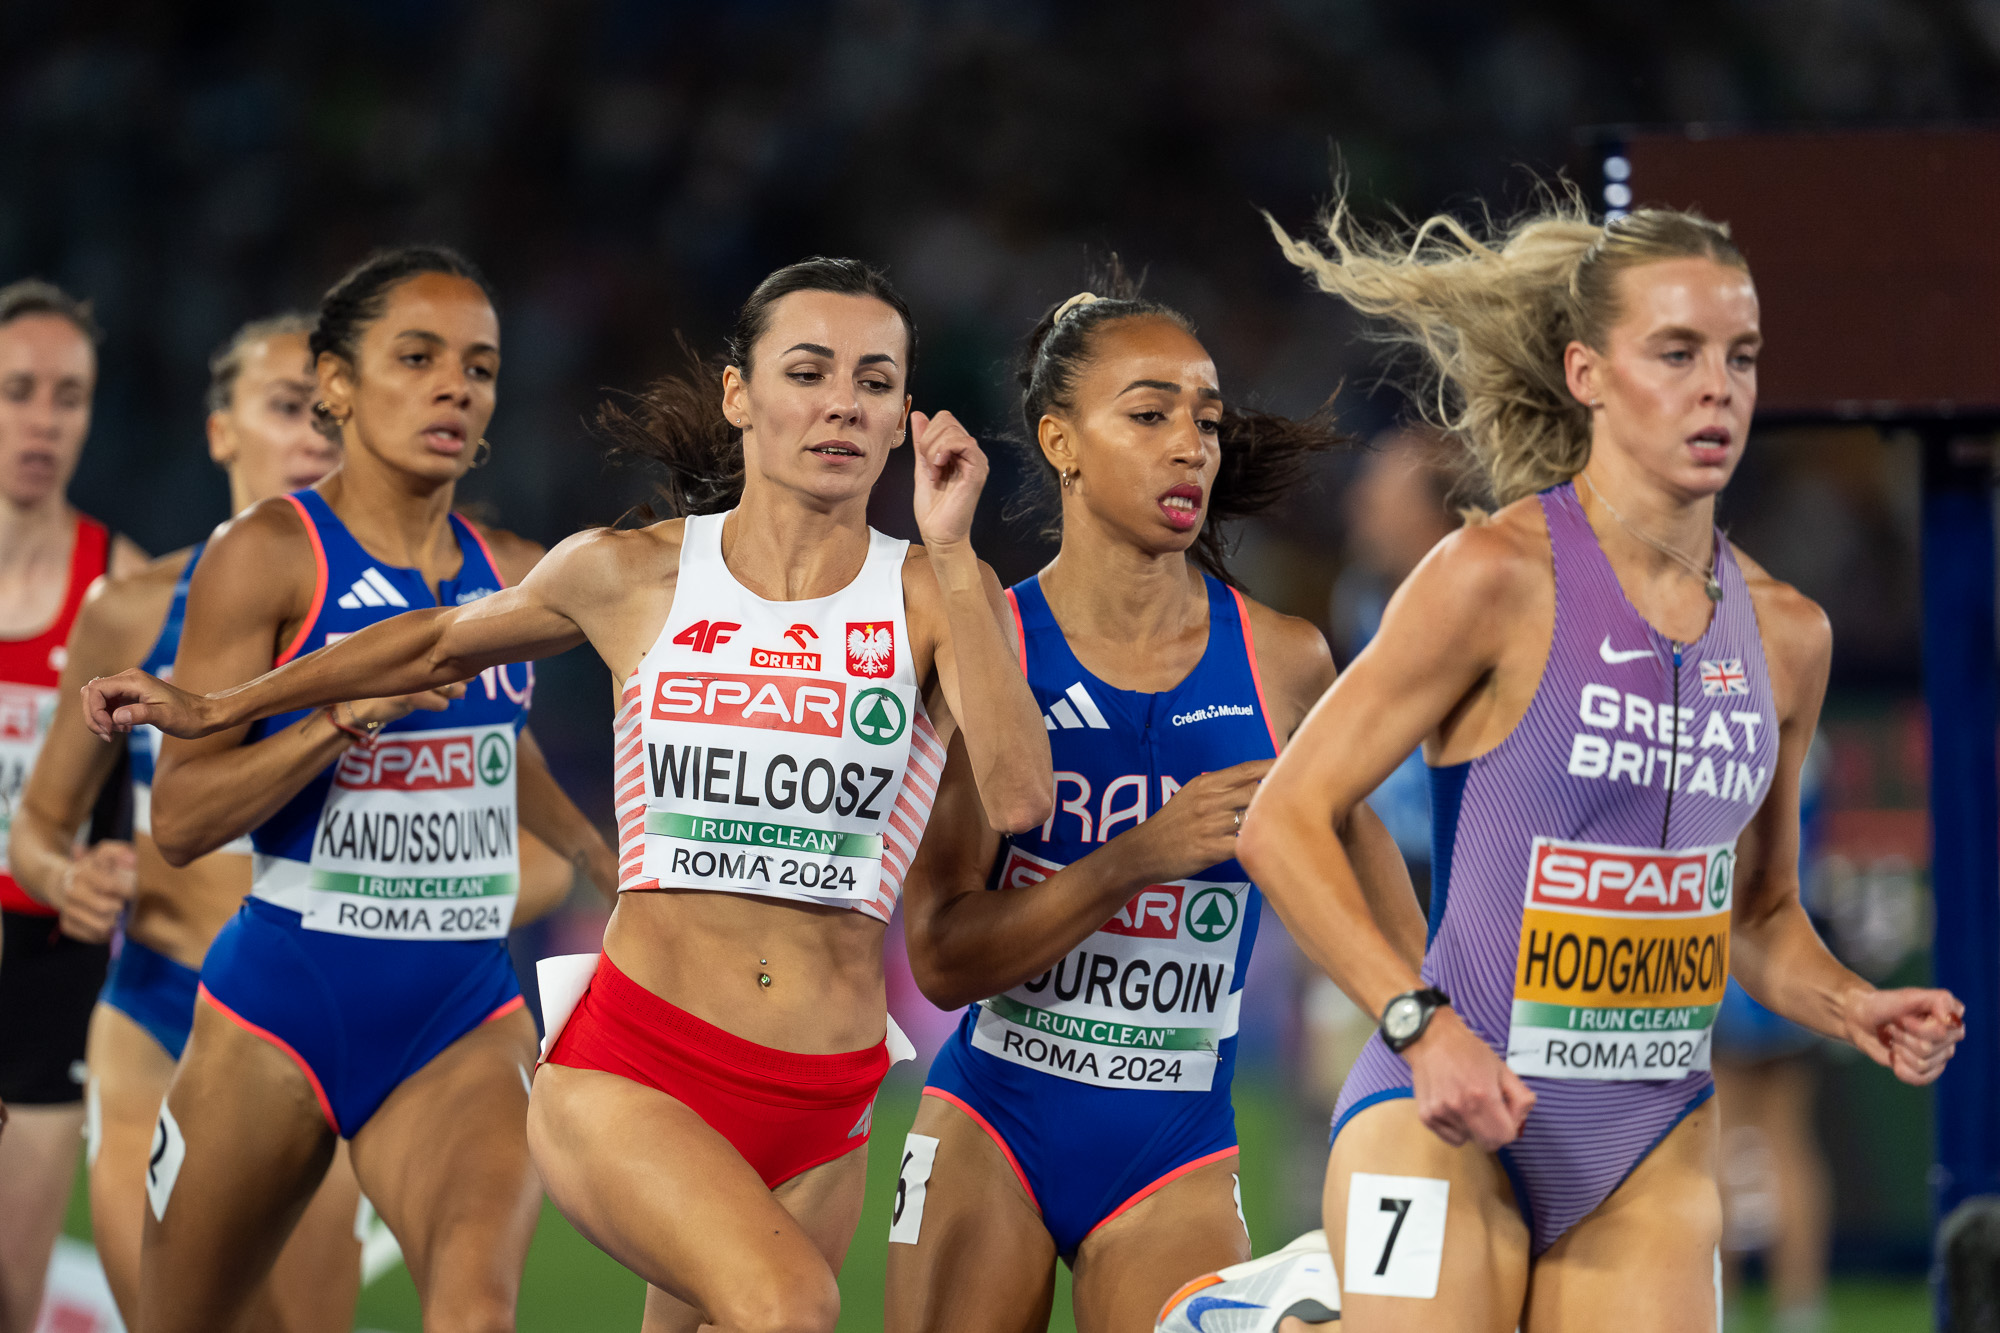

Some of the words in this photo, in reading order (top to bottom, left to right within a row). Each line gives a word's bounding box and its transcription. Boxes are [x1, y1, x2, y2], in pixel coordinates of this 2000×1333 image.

[672, 619, 742, 654] 4F
[754, 651, 817, 670] ORLEN
[658, 678, 840, 729] SPAR
[1172, 708, 1207, 726] Crédit
[1217, 704, 1254, 717] Mutuel
[1579, 682, 1762, 754] GREAT
[339, 742, 472, 785] SPAR
[647, 743, 894, 820] WIELGOSZ
[1567, 732, 1766, 805] BRITAIN
[318, 806, 513, 863] KANDISSOUNON
[691, 819, 697, 837] I
[701, 820, 753, 842] RUN
[358, 877, 365, 893] I
[369, 878, 416, 898] RUN
[671, 847, 771, 883] ROMA
[779, 859, 857, 891] 2024
[1538, 854, 1704, 906] SPAR
[338, 902, 431, 931] ROMA
[440, 905, 501, 932] 2024
[1524, 929, 1726, 994] HODGKINSON
[1024, 1008, 1032, 1024] I
[1035, 1011, 1086, 1038] RUN
[1568, 1008, 1576, 1028] I
[1580, 1009, 1626, 1030] RUN
[1003, 1029, 1099, 1078] ROMA
[1108, 1055, 1183, 1084] 2024
[1545, 1040, 1638, 1068] ROMA
[1644, 1040, 1698, 1068] 202
[1373, 1197, 1413, 1277] 7
